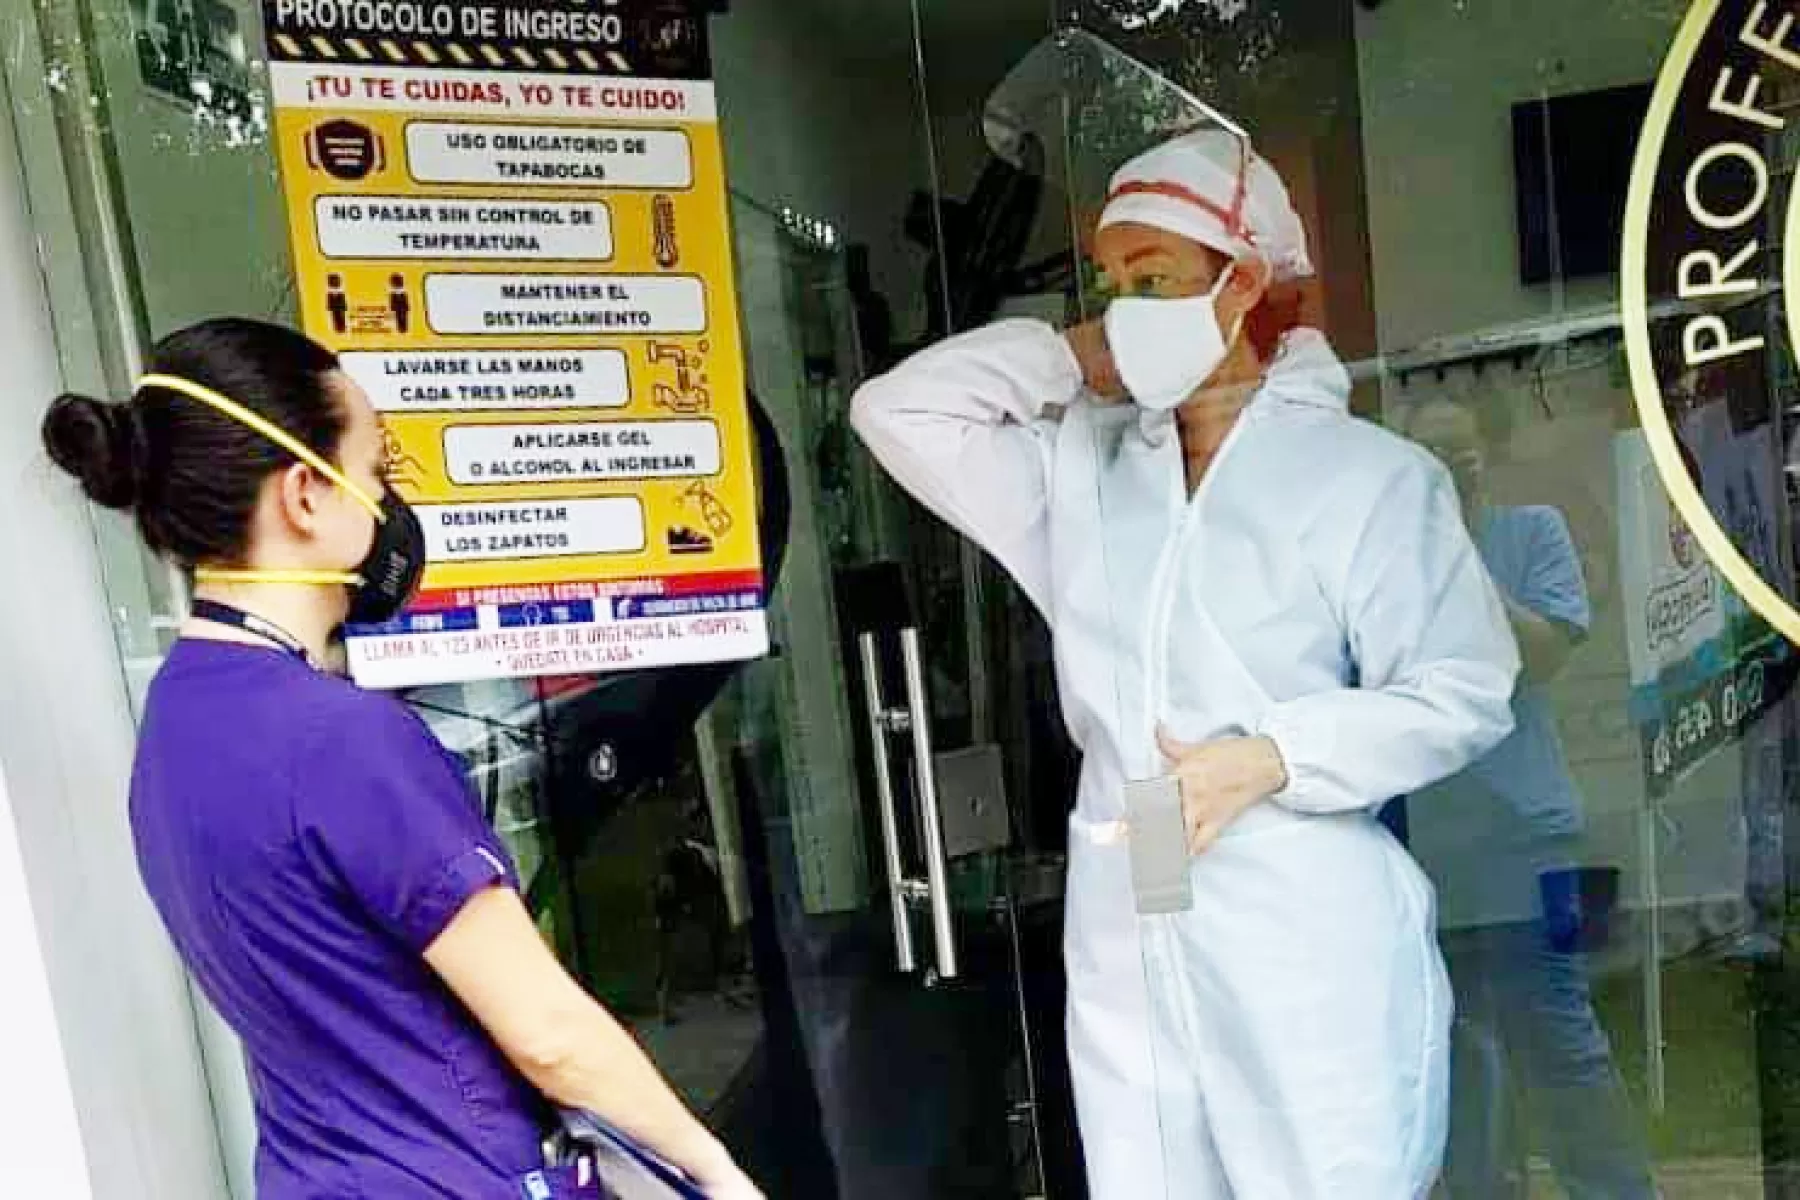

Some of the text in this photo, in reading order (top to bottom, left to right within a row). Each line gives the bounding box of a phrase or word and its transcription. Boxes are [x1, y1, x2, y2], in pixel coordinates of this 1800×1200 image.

[278, 0, 453, 36] PROTOCOLO
[461, 8, 496, 37] DE
[504, 11, 622, 44] INGRESO
[366, 77, 396, 101] TE
[404, 79, 511, 108] CUIDAS,
[522, 84, 554, 106] YO
[564, 86, 593, 107] TE
[601, 86, 686, 110] CUIDO!
[446, 133, 647, 155] USO OBLIGATORIO DE
[496, 161, 605, 181] TAPABOCAS
[332, 205, 594, 226] NO PASAR SIN CONTROL DE
[400, 234, 540, 252] TEMPERATURA
[501, 284, 630, 301] MANTENER EL
[484, 310, 652, 327] DISTANCIAMIENTO
[384, 356, 583, 376] LAVARSE LAS MANOS
[400, 384, 576, 402] CADA TRES HORAS
[512, 430, 652, 450] APLICARSE GEL
[470, 454, 696, 477] O ALCOHOL AL INGRESAR
[441, 508, 568, 527] DESINFECTAR
[446, 533, 570, 552] LOS ZAPATOS
